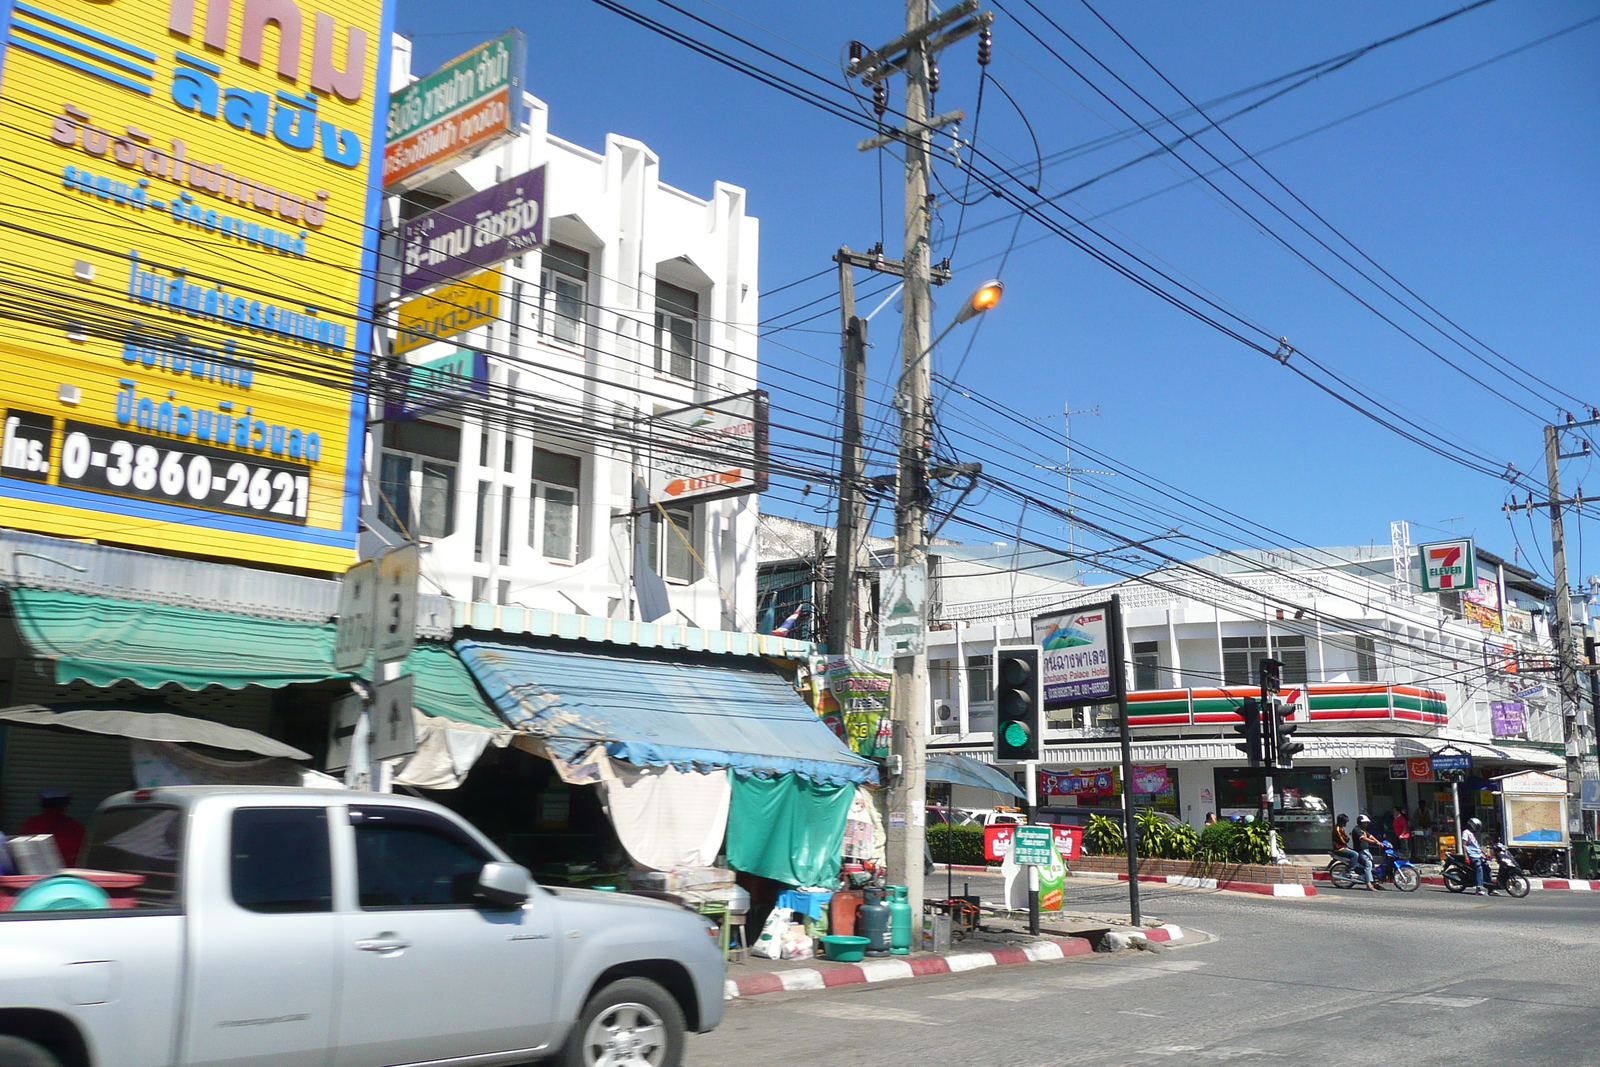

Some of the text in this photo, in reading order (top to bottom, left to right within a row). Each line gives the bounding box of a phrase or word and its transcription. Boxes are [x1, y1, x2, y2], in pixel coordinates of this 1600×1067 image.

[51, 103, 330, 228] รับจัดไฟแนนซ์
[1, 416, 309, 518] โทร. 0-3860-2621
[1069, 670, 1090, 679] Palace
[1091, 667, 1108, 677] Hotel
